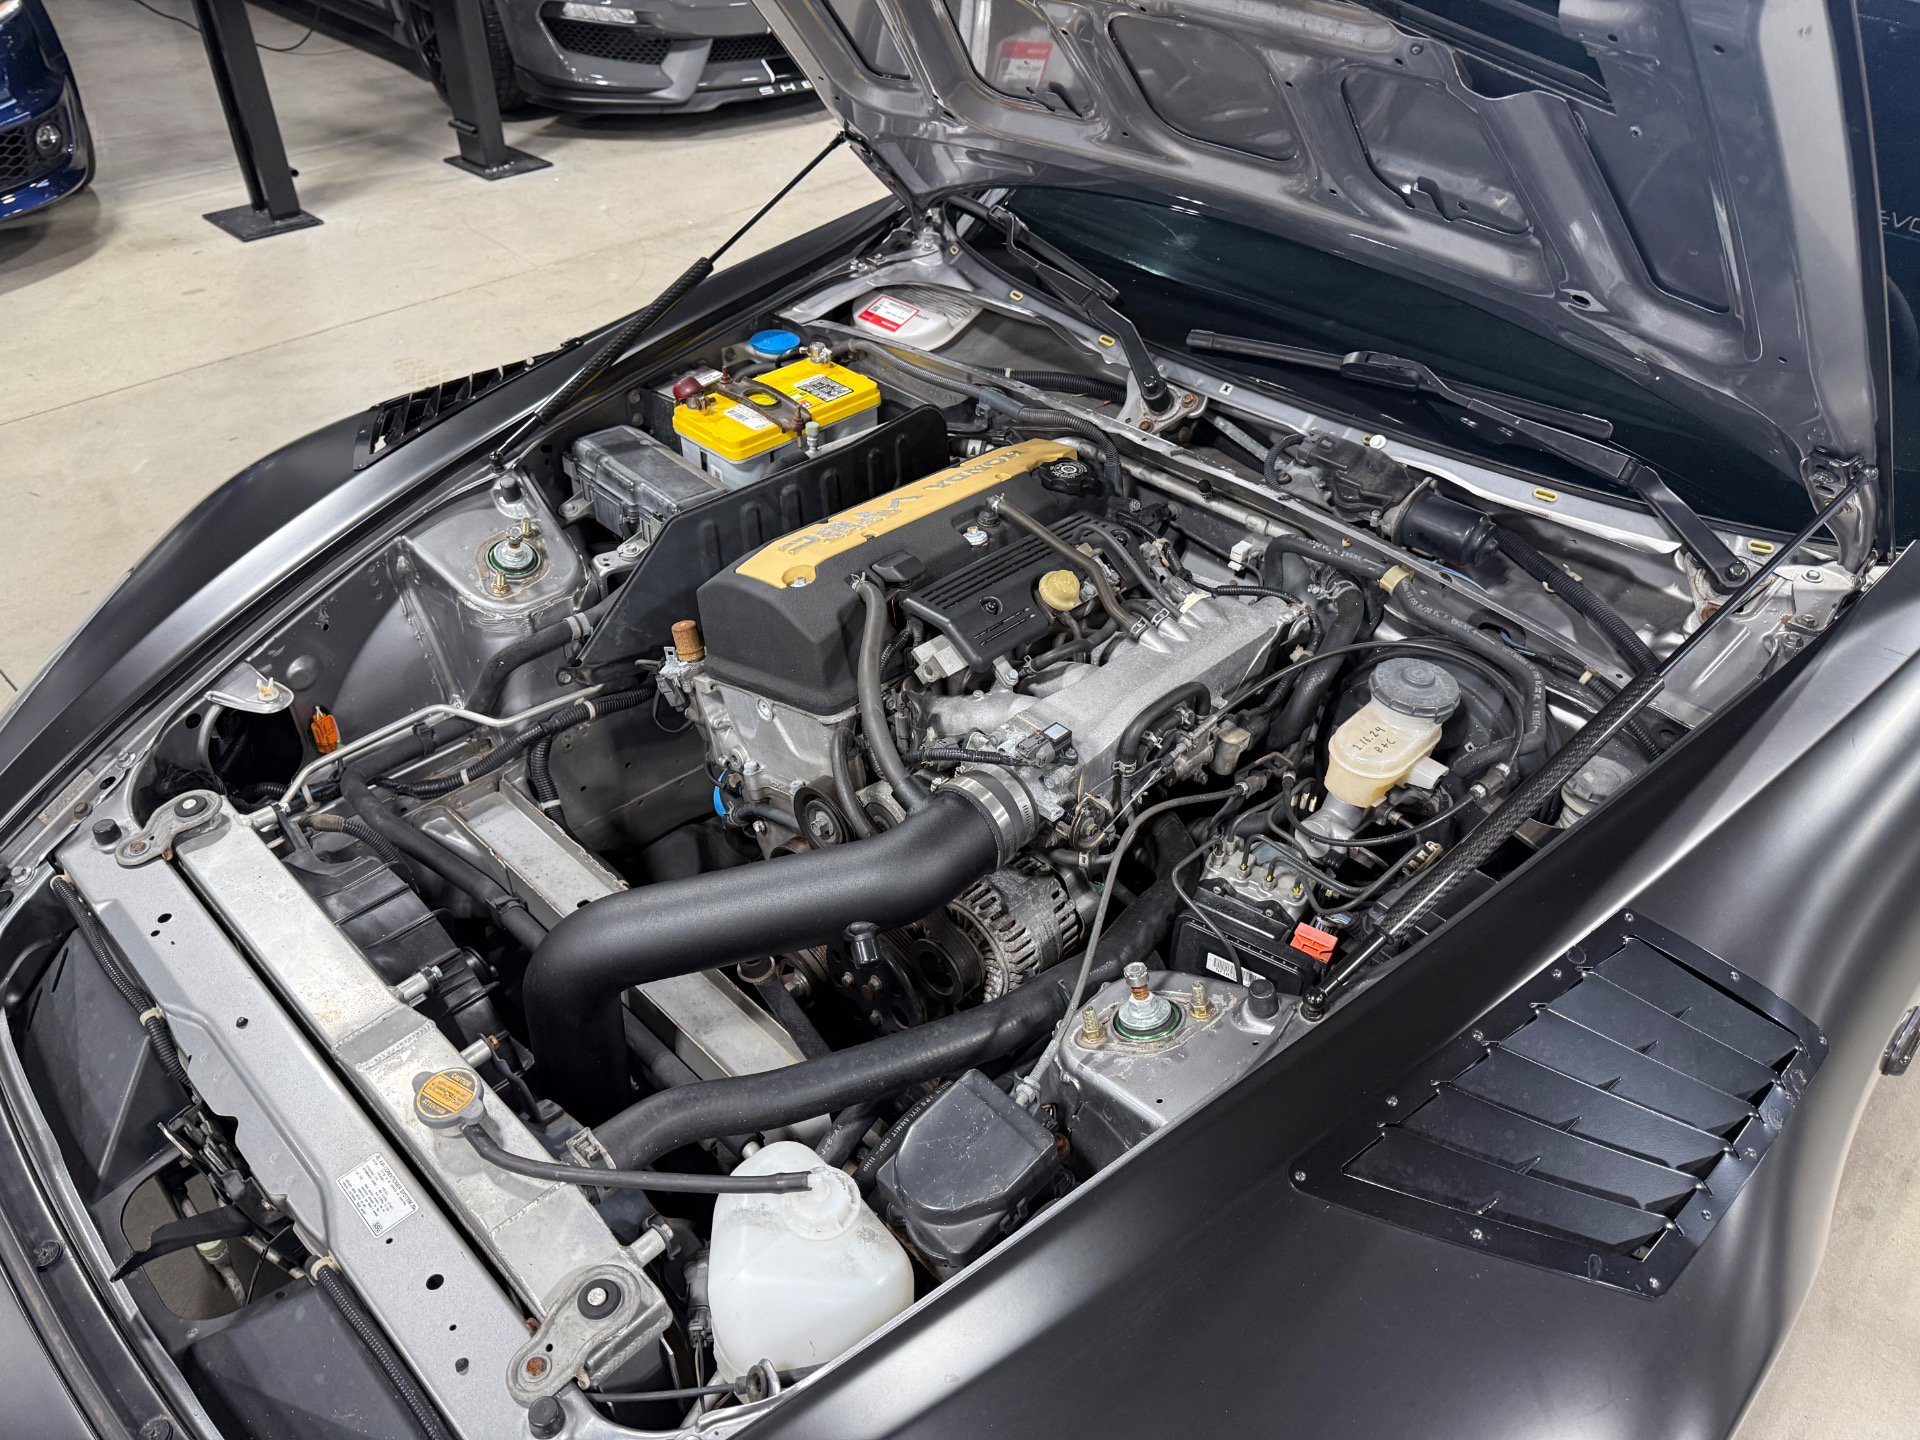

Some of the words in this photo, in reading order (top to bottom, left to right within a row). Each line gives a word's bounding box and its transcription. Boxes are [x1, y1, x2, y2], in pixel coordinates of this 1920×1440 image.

[922, 450, 1024, 490] HONDA
[451, 1072, 473, 1087] CAUTION
[422, 1098, 447, 1114] ATTENTION
